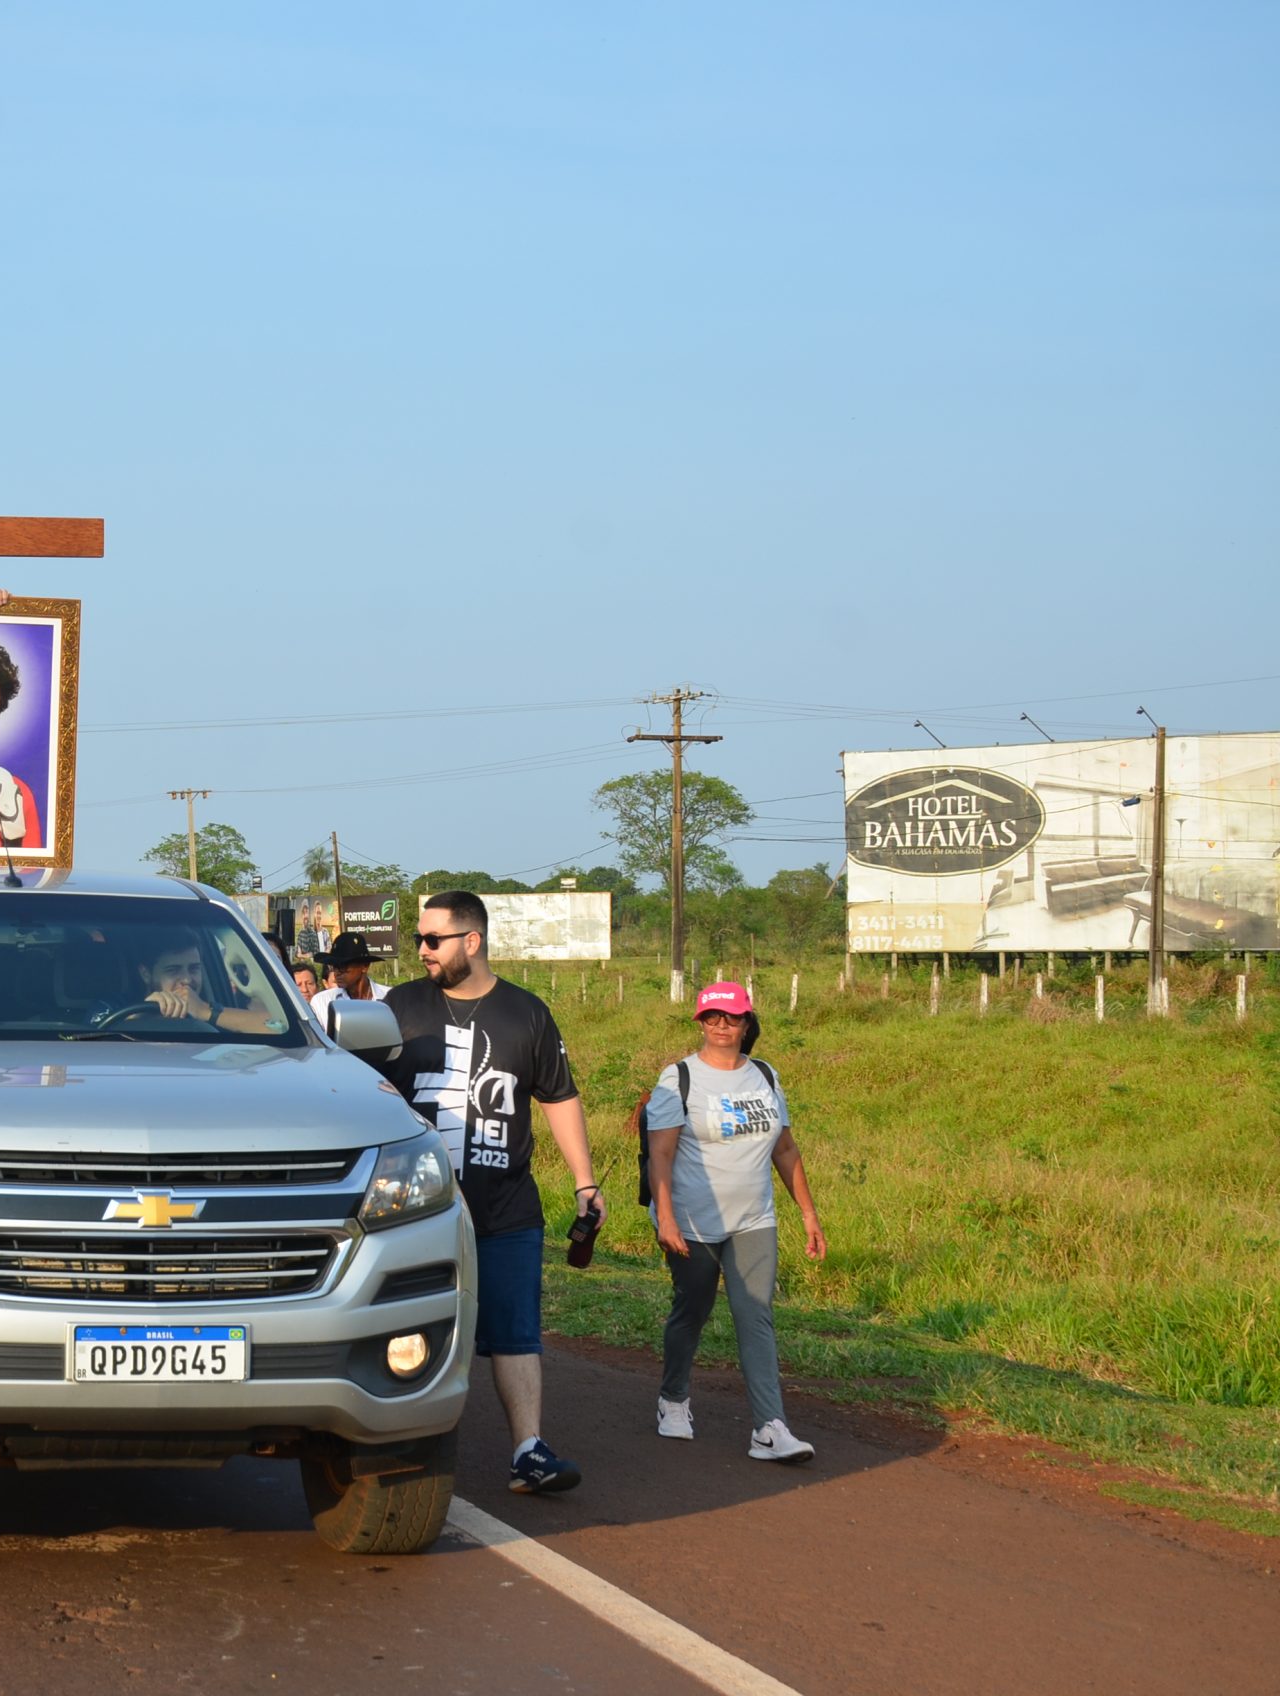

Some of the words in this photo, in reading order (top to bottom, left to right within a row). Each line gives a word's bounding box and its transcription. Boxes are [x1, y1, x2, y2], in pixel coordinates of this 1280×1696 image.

[908, 796, 983, 820] HOTEL
[864, 819, 1017, 848] BAHAMAS
[344, 911, 381, 921] FORTERRA
[708, 992, 735, 1001] Sicredi
[721, 1098, 765, 1113] SANTO
[735, 1108, 779, 1124] SANTO
[471, 1117, 508, 1149] JEJ
[721, 1120, 770, 1137] SANTO
[470, 1148, 509, 1169] 2023
[146, 1331, 174, 1340] BRASIL
[90, 1345, 227, 1376] QPD9G45
[77, 1368, 87, 1378] BR
